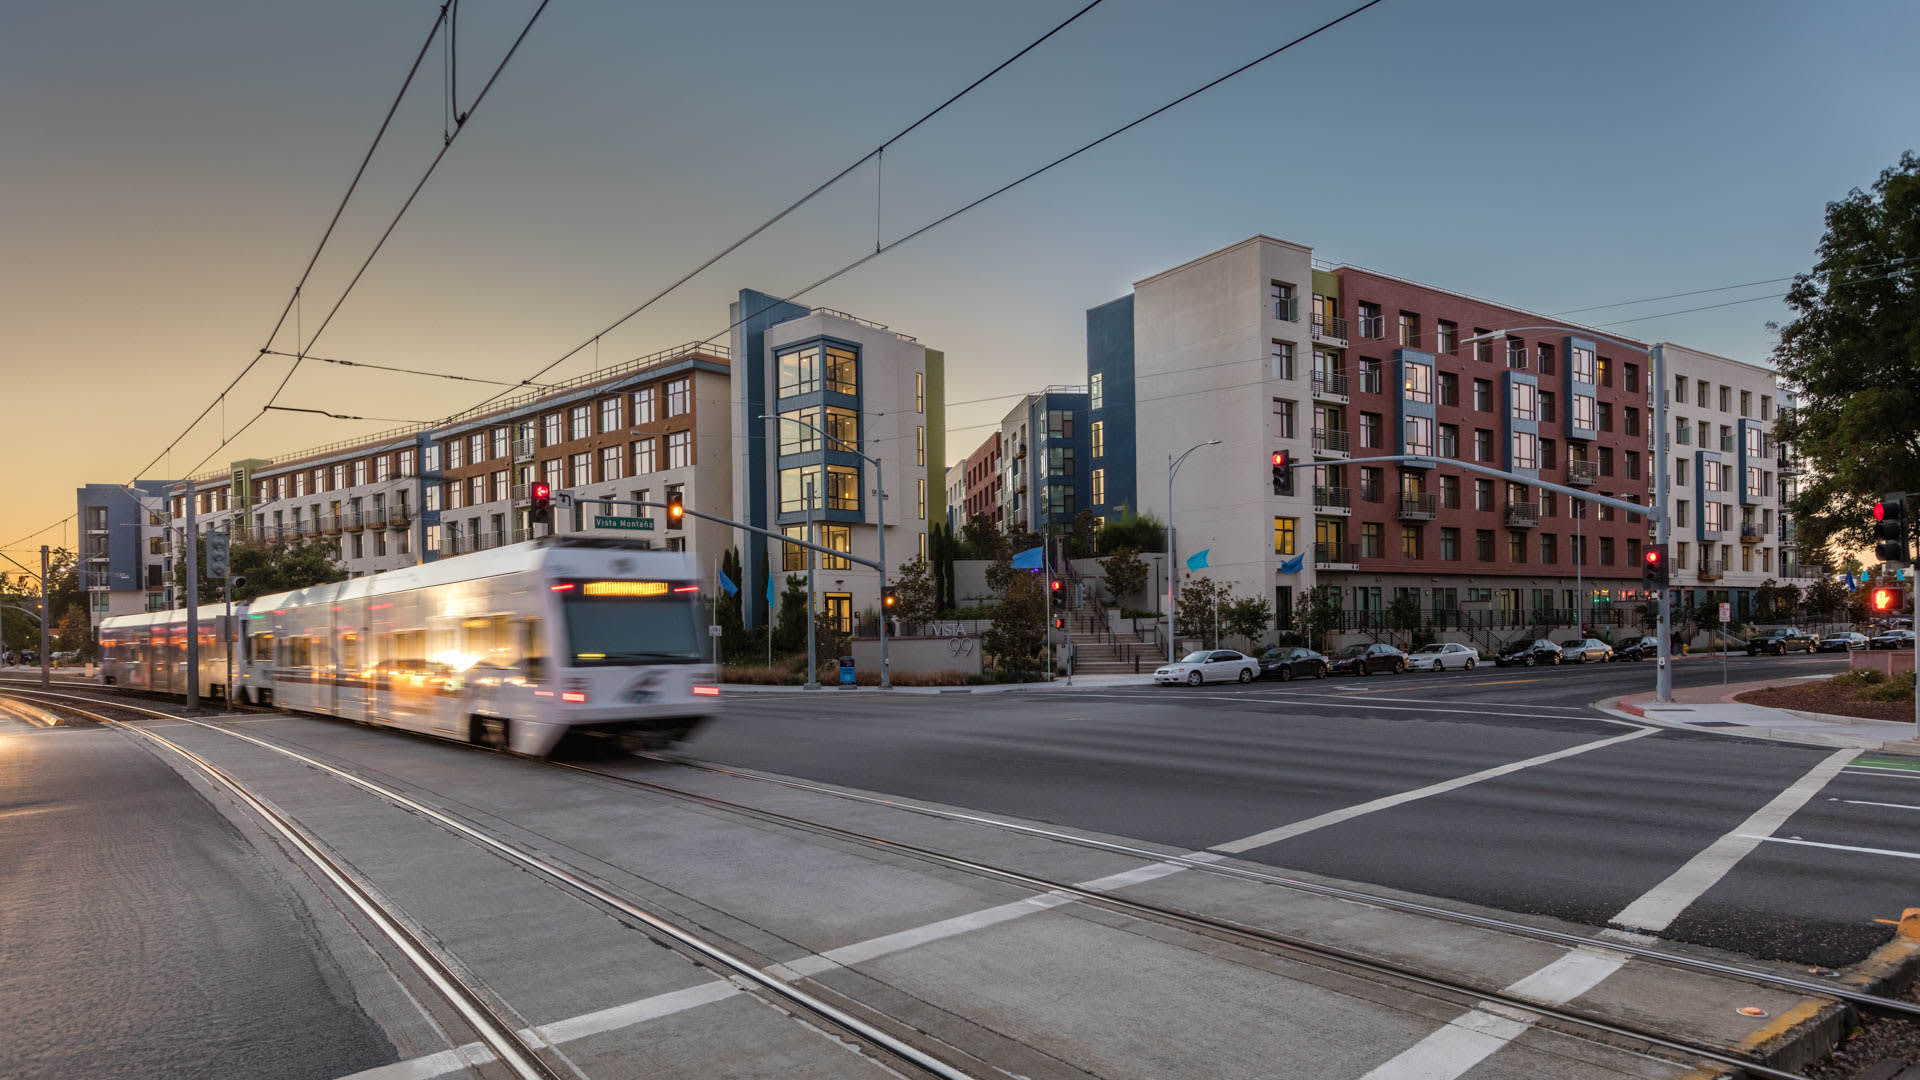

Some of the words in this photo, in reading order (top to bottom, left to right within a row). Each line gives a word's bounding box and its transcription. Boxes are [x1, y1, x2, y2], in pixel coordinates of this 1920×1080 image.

[596, 519, 616, 527] Vista
[932, 623, 967, 636] VISTA
[949, 638, 972, 656] 99
